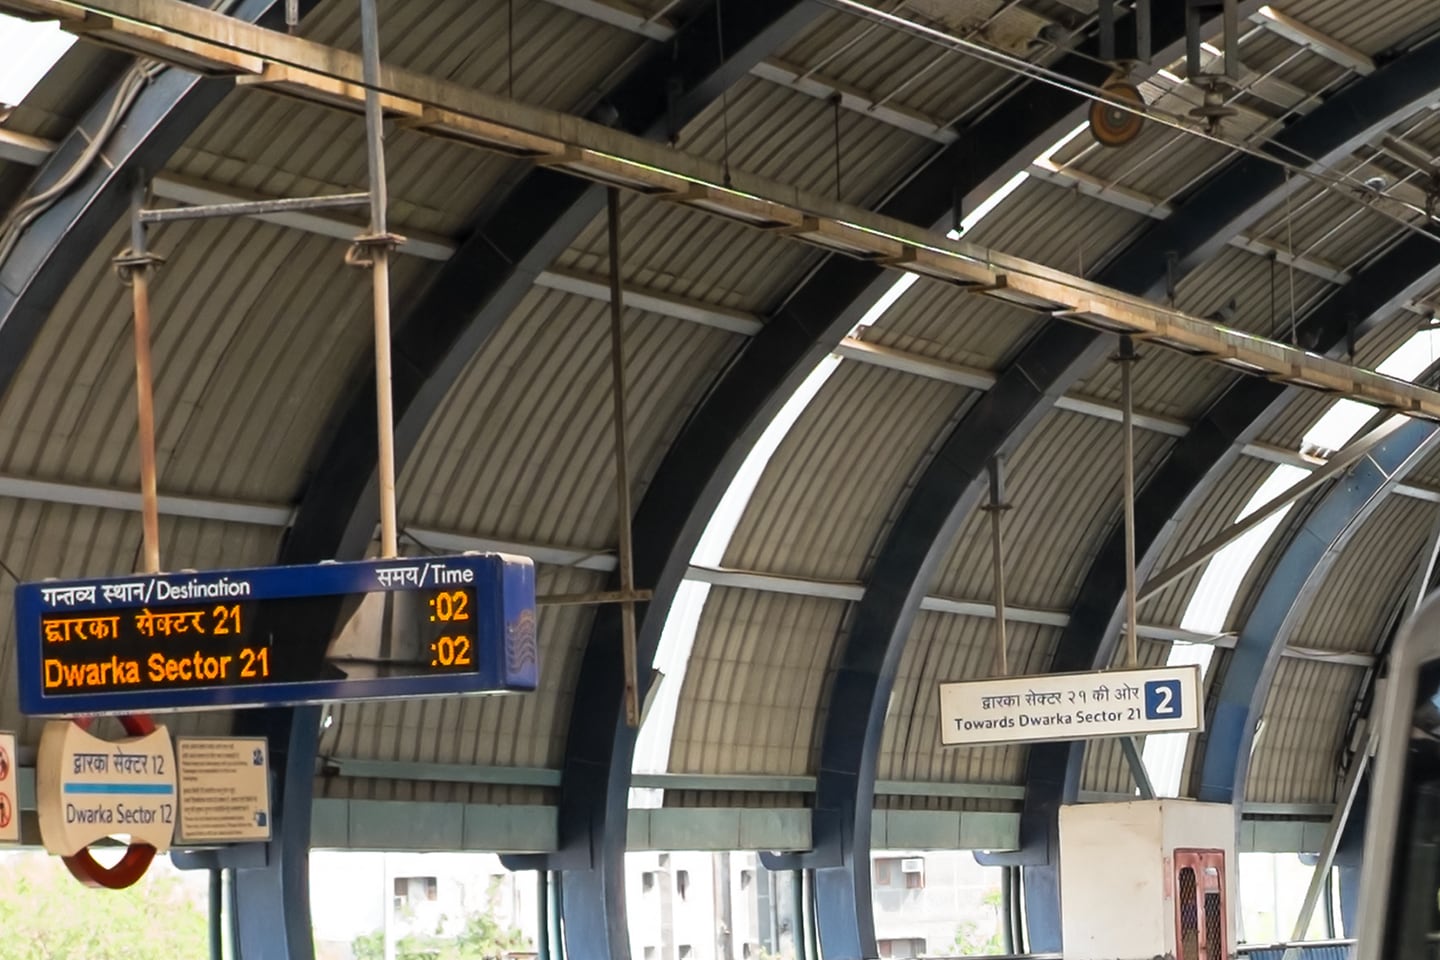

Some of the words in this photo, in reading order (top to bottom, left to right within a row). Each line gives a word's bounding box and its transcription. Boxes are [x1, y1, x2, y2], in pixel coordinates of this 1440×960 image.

[41, 585, 97, 607] गन्तव्य
[43, 615, 121, 642] द्वारका
[135, 608, 206, 637] सेक्टर
[212, 604, 242, 636] 21
[44, 655, 141, 688] Dwarka
[148, 650, 232, 682] Sector
[239, 647, 269, 678] 21
[981, 694, 1021, 710] द्वारका
[1025, 689, 1062, 706] सेक्टर
[1092, 683, 1109, 702] की
[1114, 682, 1139, 700] ओर
[1155, 685, 1174, 714] 2
[954, 716, 1015, 731] Towards
[1019, 713, 1072, 727] Dwarka
[1076, 710, 1122, 724] Sector
[1127, 707, 1141, 720] 21
[73, 753, 109, 775] द्वारका
[113, 745, 148, 774] सेक्टर
[152, 755, 165, 775] 12
[66, 803, 113, 824] Dwarka
[116, 803, 157, 824] Sector
[160, 804, 172, 824] 12
